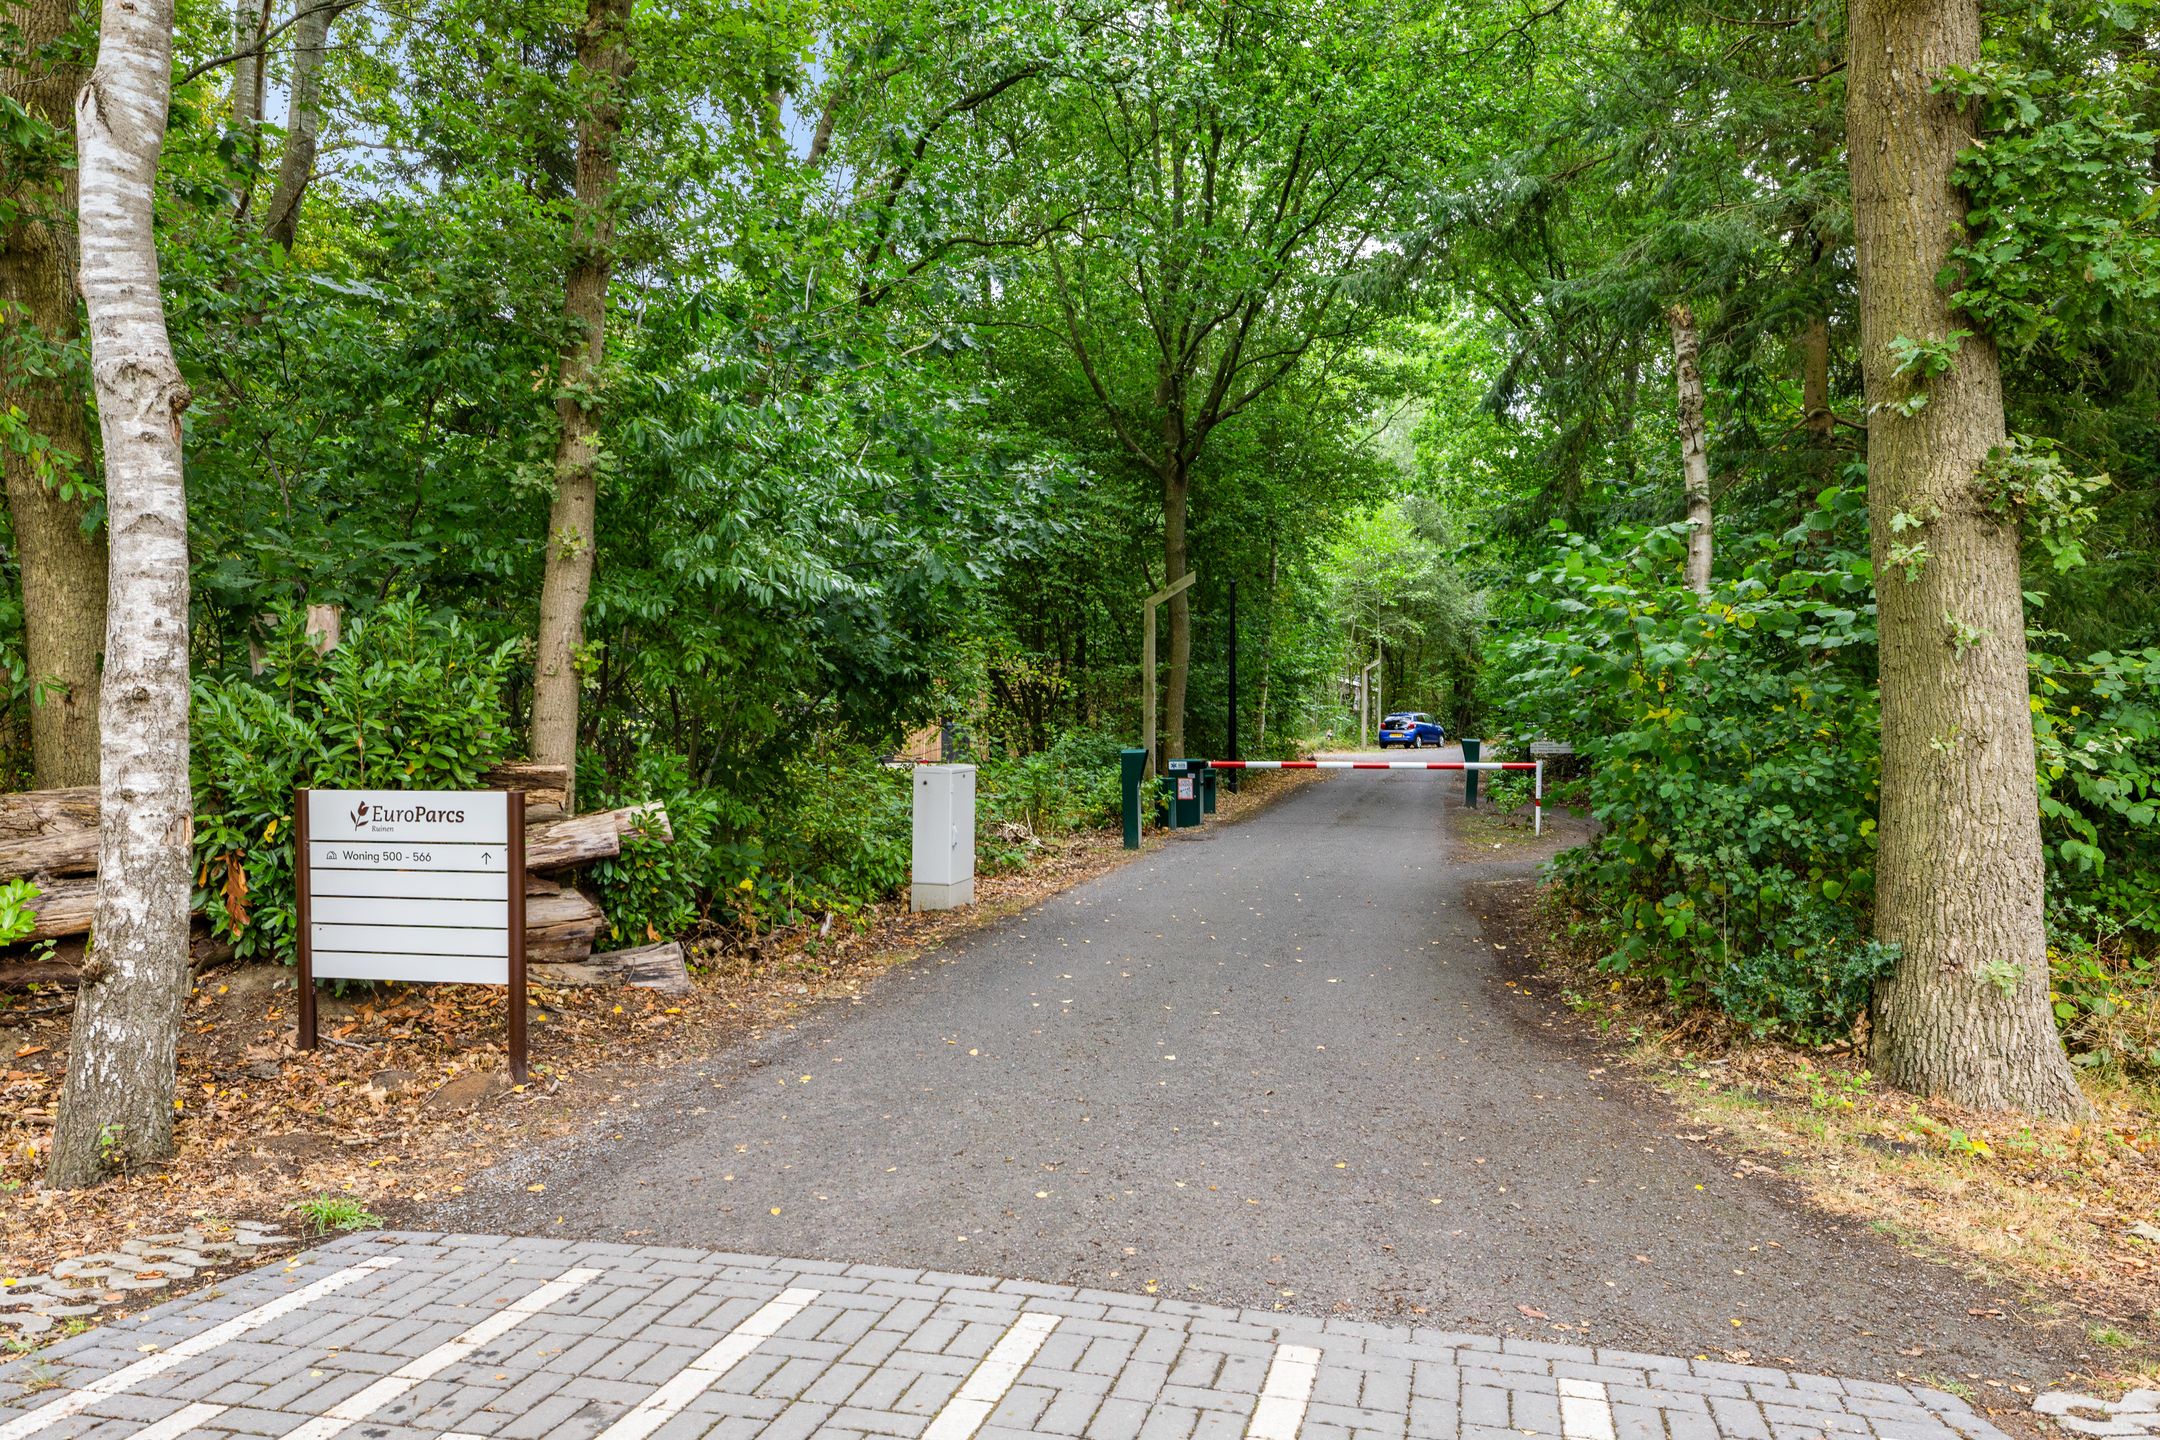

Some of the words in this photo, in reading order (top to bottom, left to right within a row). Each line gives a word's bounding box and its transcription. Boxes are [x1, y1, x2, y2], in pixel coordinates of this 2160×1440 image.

[371, 805, 465, 823] EuroParcs
[342, 850, 380, 863] Woning
[382, 851, 403, 862] 500
[412, 852, 432, 862] 566
